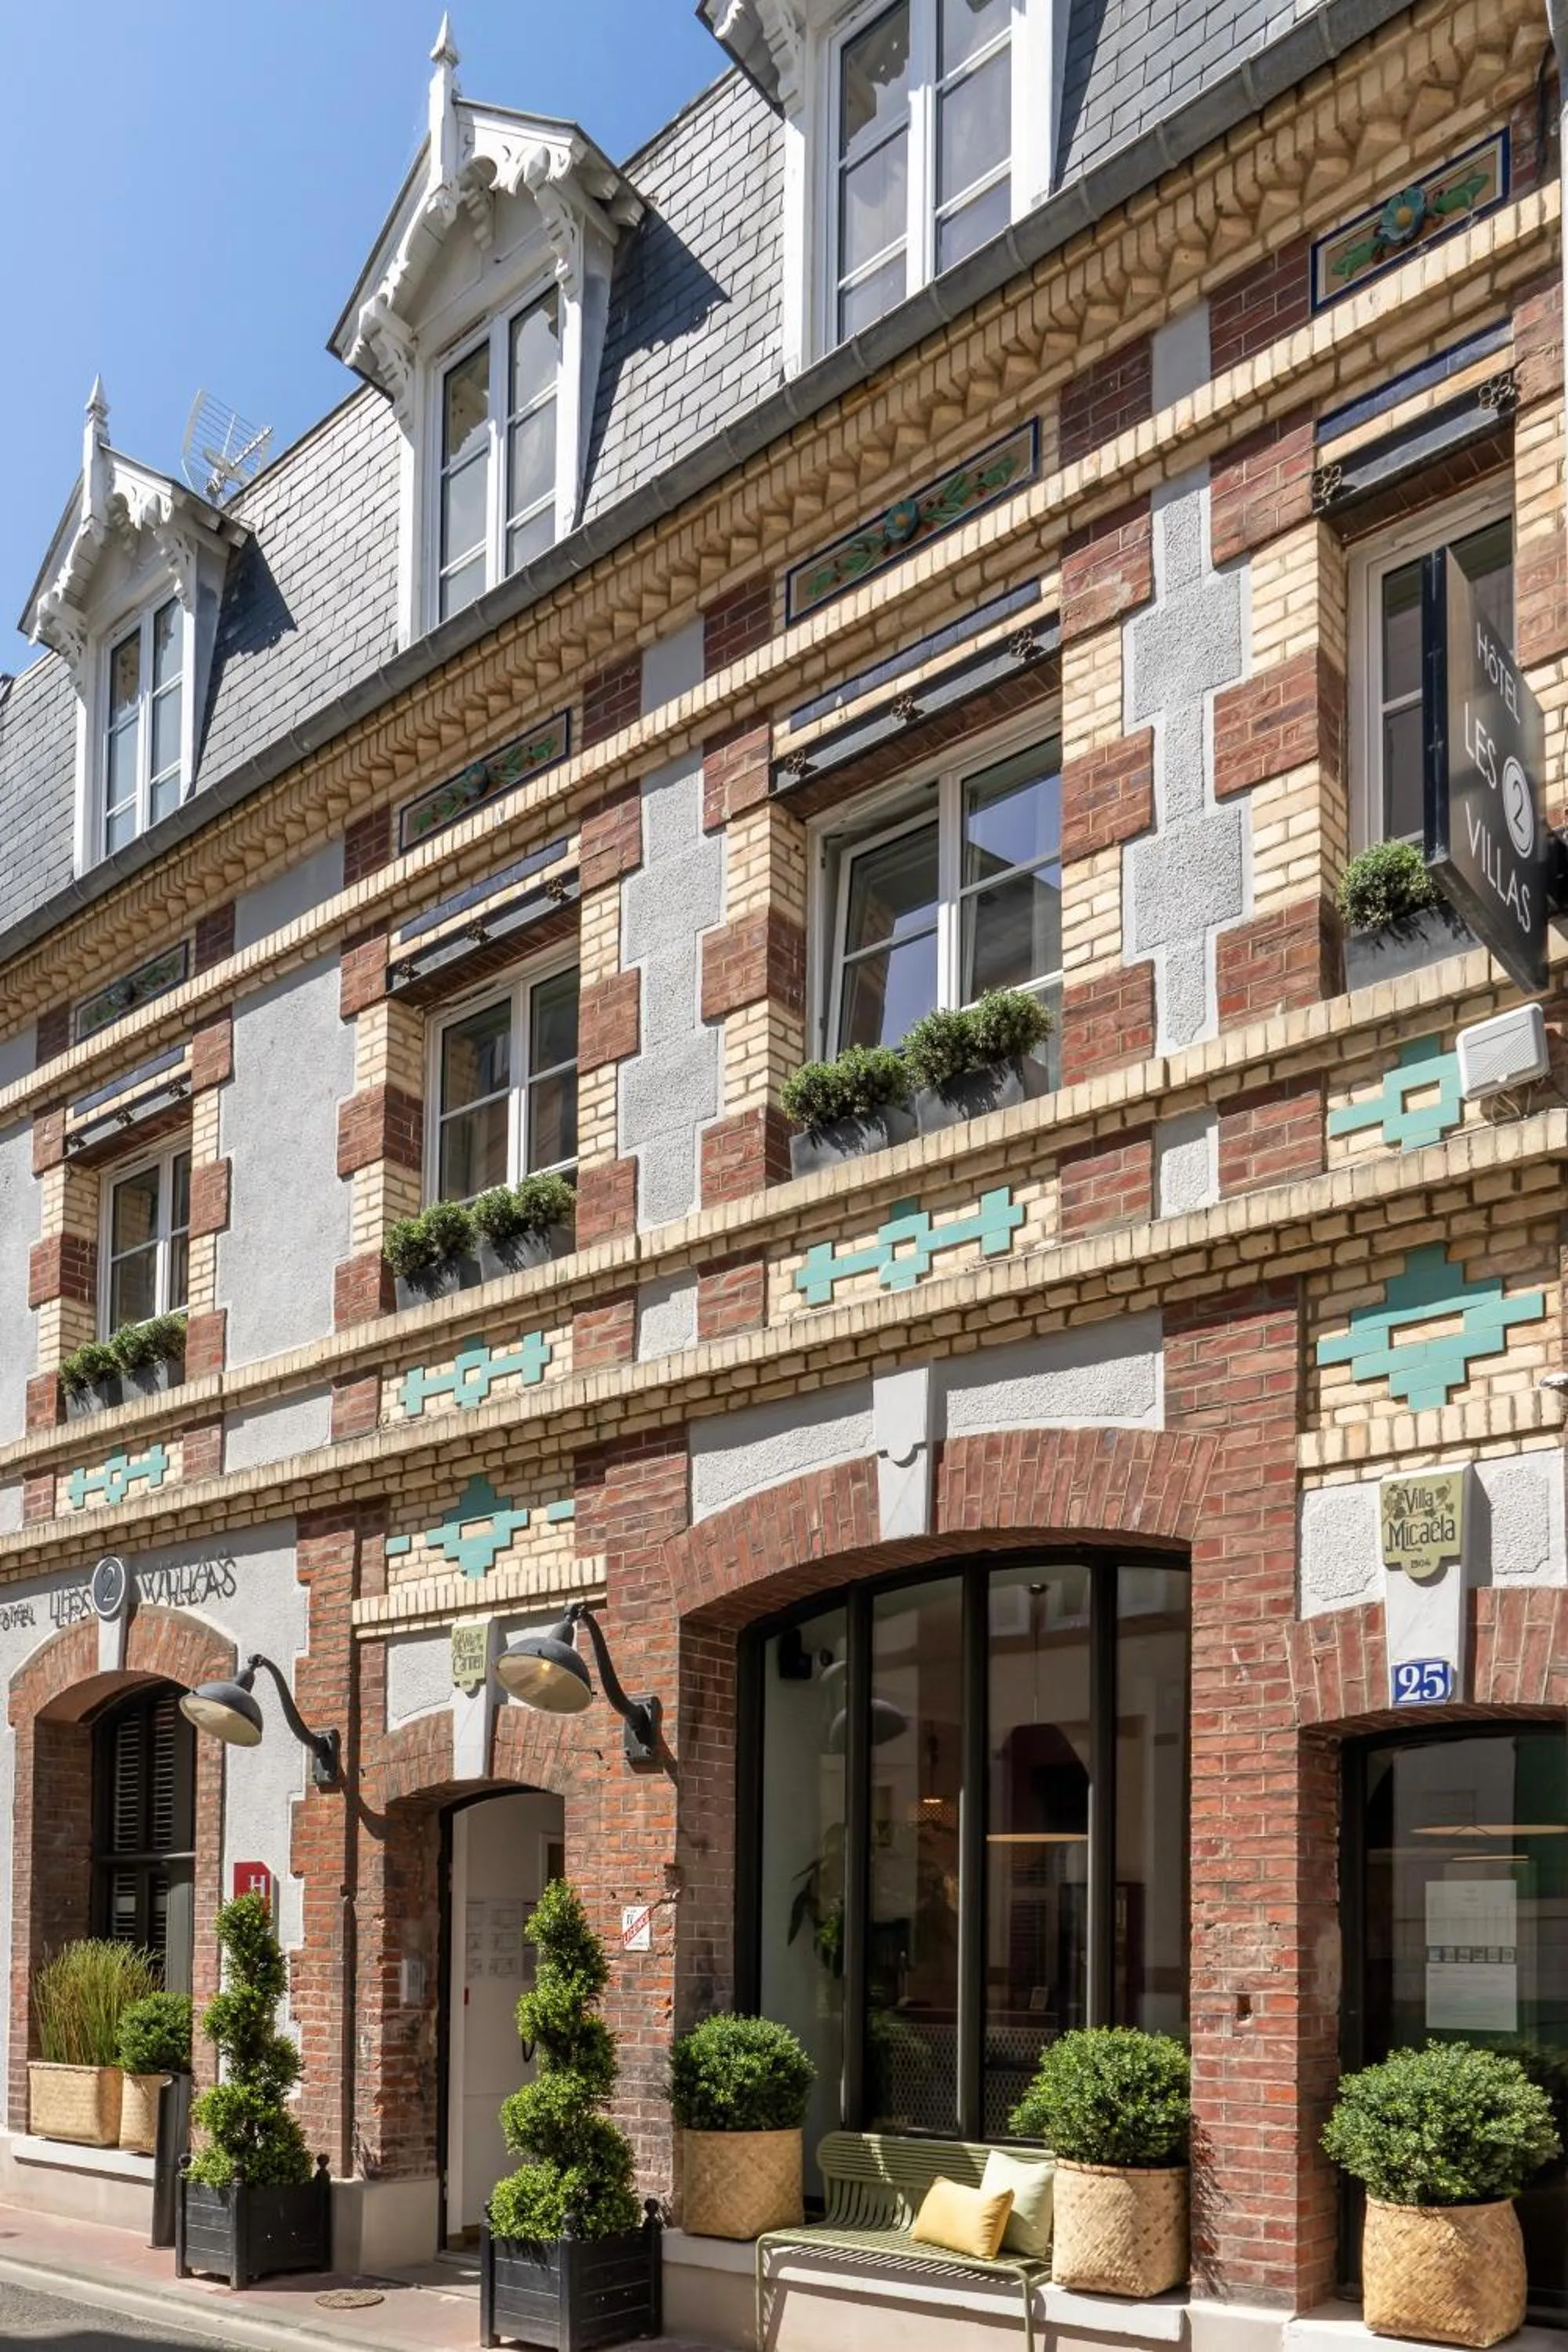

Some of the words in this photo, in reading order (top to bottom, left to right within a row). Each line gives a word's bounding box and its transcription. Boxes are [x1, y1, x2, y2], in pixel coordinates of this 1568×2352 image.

[1477, 621, 1522, 726] HÔTEL
[1465, 701, 1497, 790] LES
[1512, 780, 1525, 833] 2
[1465, 801, 1530, 934] VILLAS
[1403, 1487, 1435, 1515] Villa
[103, 1566, 116, 1602] 2
[136, 1551, 237, 1606] VILLAS
[1398, 1662, 1446, 1702] 25
[249, 1874, 267, 1897] H
